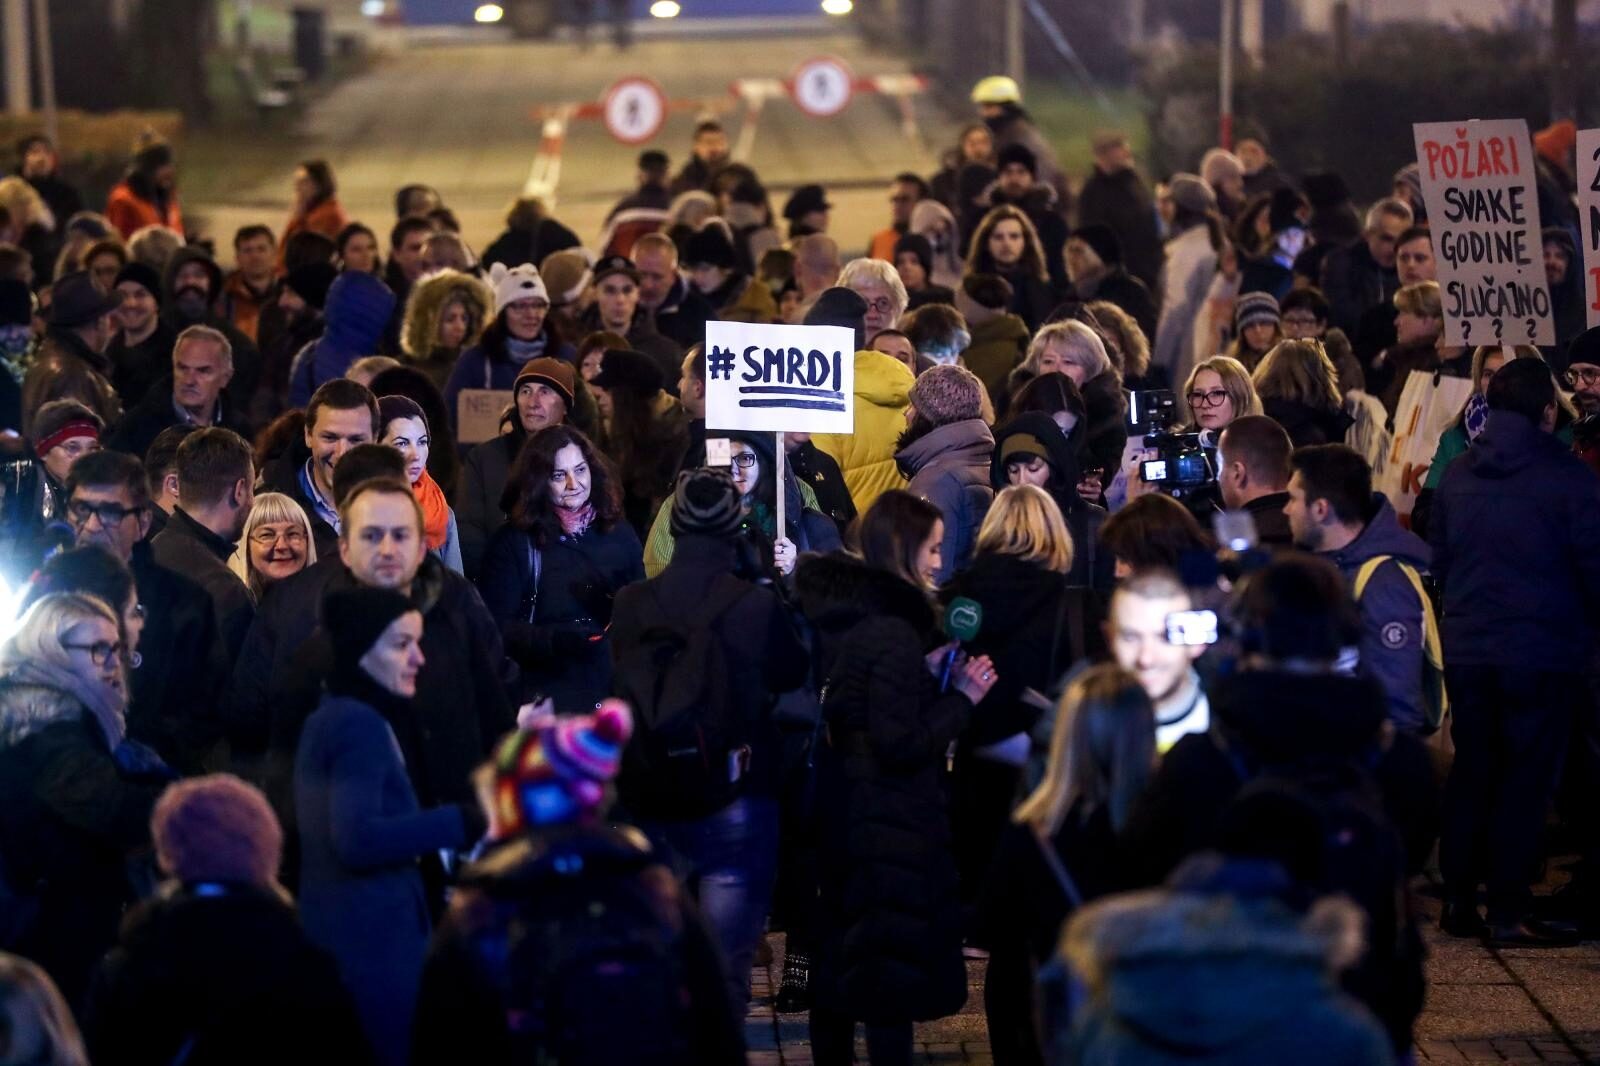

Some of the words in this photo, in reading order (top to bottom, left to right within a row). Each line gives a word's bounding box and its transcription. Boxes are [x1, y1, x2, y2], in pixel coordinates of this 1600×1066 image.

[1423, 127, 1521, 180] POŽARI
[1444, 186, 1527, 225] SVAKE
[1441, 230, 1532, 270] GODINE
[1447, 275, 1550, 319] SLUČAJNO
